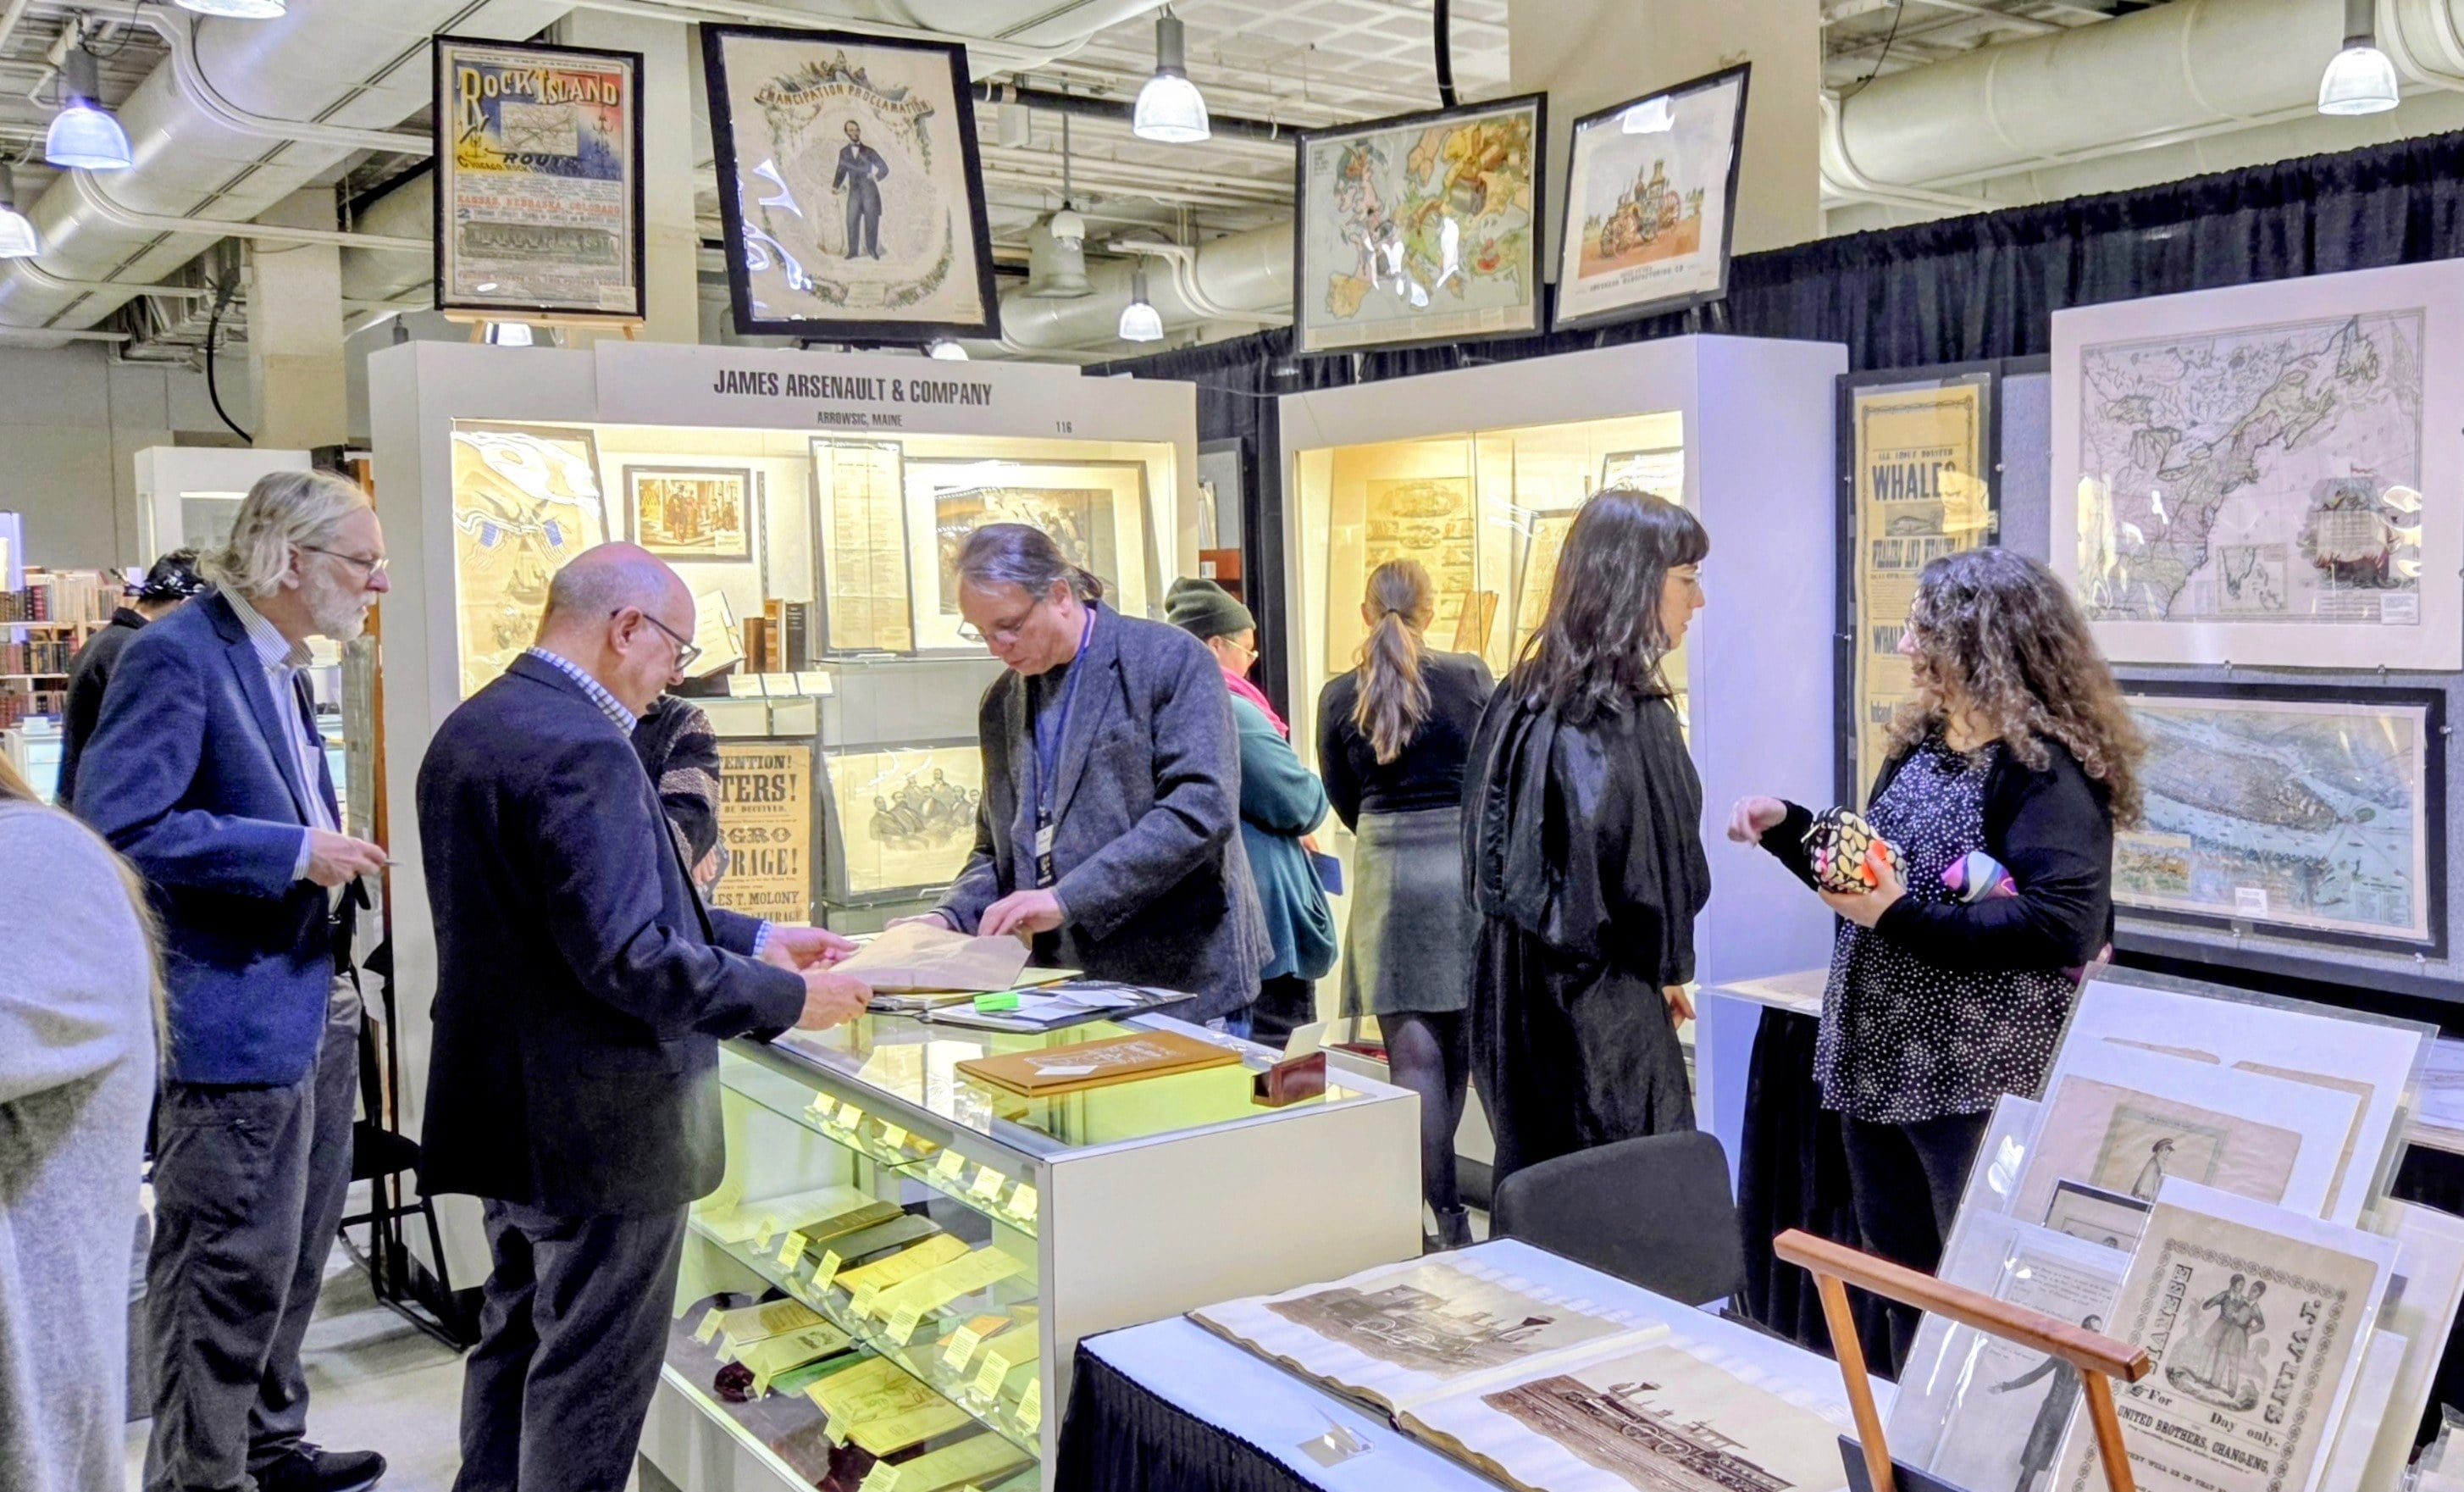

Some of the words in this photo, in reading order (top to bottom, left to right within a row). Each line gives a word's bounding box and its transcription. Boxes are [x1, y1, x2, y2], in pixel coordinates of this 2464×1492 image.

[758, 84, 844, 105] EMANCIPATION
[848, 85, 929, 114] PROCLAMATION
[713, 369, 779, 397] JAMES
[786, 374, 886, 401] ARSENAULT
[892, 379, 905, 402] &
[911, 380, 992, 406] COMPANY
[817, 411, 869, 428] ARROWSIC,
[872, 413, 903, 427] MAINE
[1056, 420, 1072, 434] 116
[731, 848, 798, 876] RAGE!
[749, 890, 800, 906] MOLONY
[2118, 1404, 2153, 1428] UNITED
[2155, 1419, 2208, 1450] BROTHERS,
[2148, 1384, 2173, 1406] For
[2210, 1412, 2238, 1433] Day
[2246, 1427, 2279, 1447] only.
